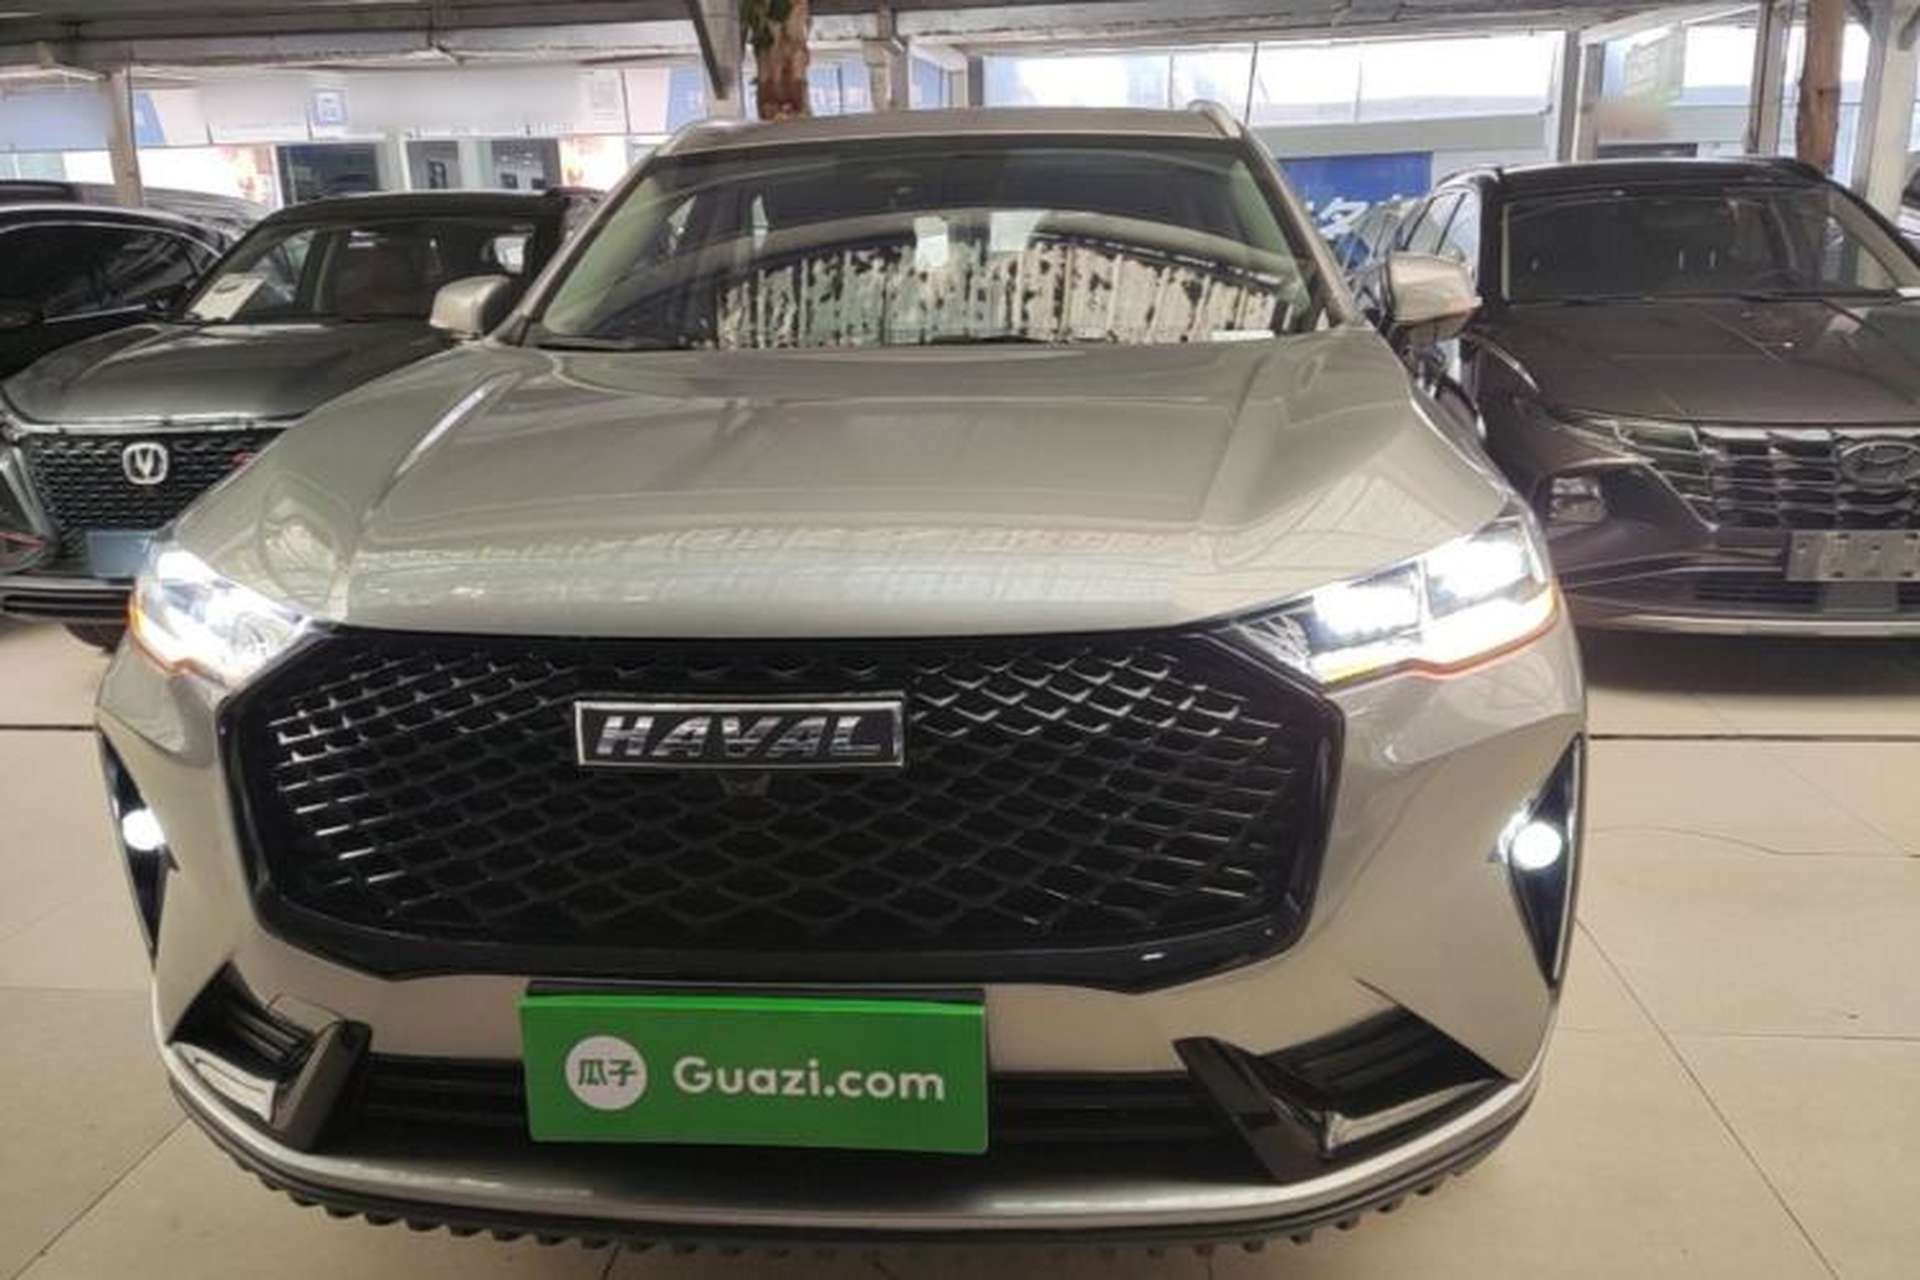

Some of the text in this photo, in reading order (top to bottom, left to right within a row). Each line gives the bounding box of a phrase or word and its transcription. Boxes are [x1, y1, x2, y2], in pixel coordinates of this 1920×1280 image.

[596, 715, 881, 757] HAVAL
[577, 1058, 637, 1087] 瓜子
[673, 1055, 945, 1100] Guazi.com
